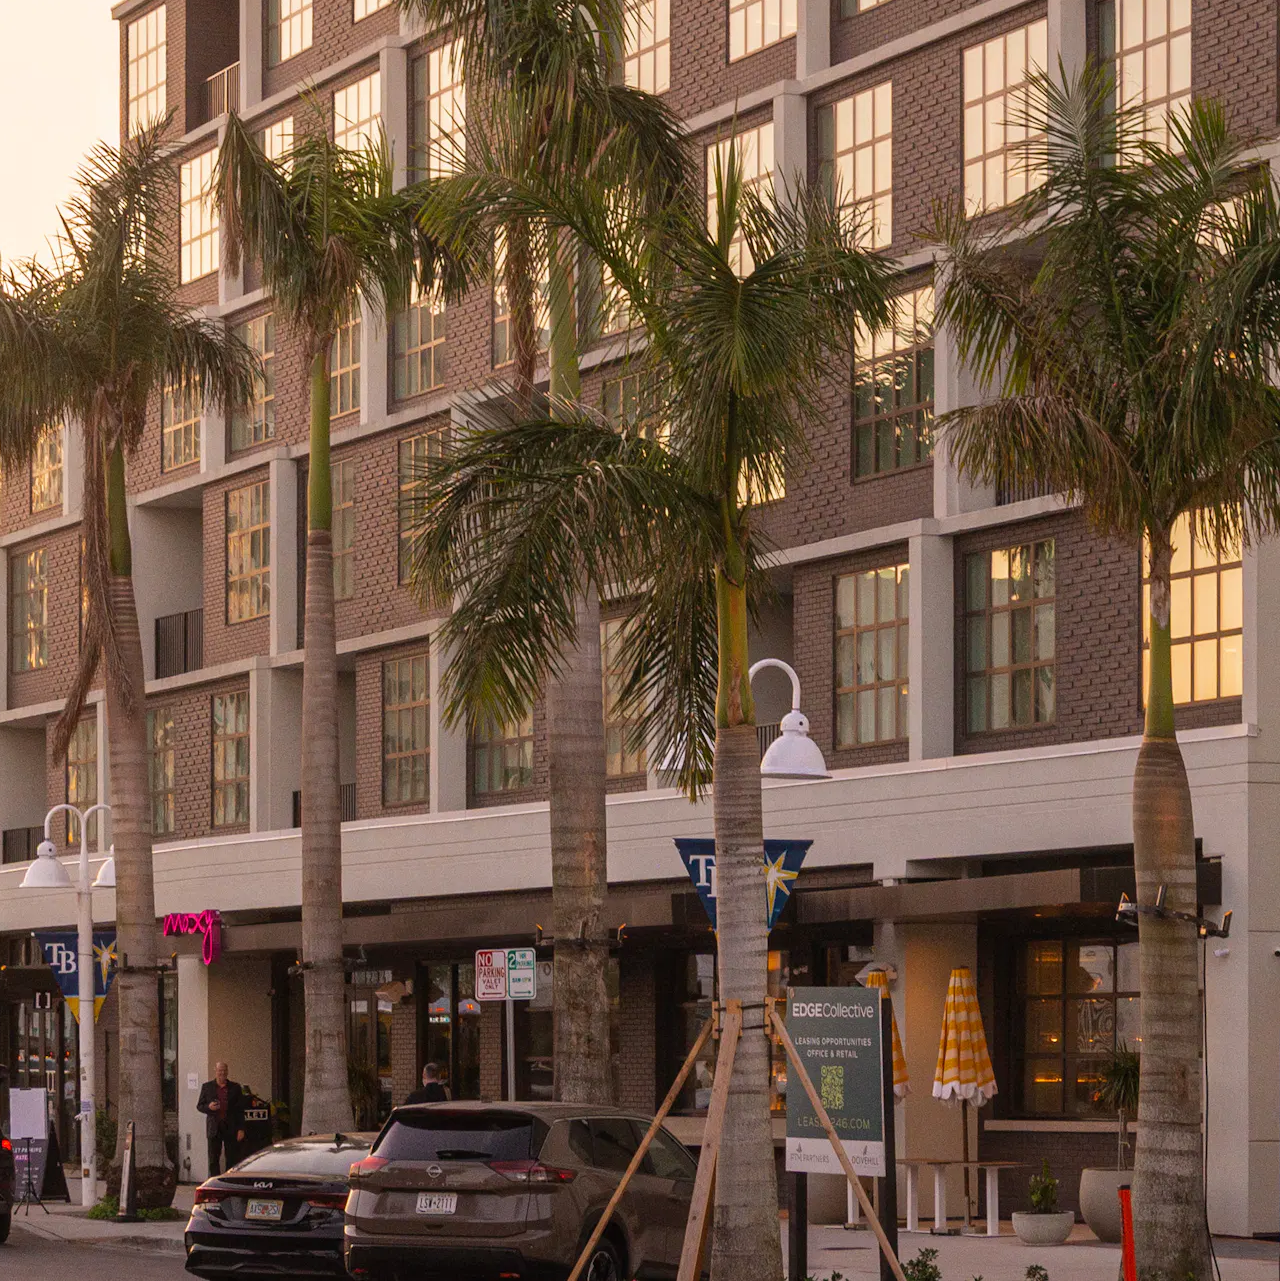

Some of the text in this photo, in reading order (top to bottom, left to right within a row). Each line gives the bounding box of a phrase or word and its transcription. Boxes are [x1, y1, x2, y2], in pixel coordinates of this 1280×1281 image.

[45, 943, 77, 974] TB
[478, 953, 492, 967] NO
[508, 953, 516, 968] 2
[479, 967, 505, 978] PARKING
[792, 1002, 874, 1018] EDGECollective
[795, 1037, 872, 1047] LEASING OPPORTUNITIES
[807, 1049, 829, 1058] OFFICE
[836, 1050, 859, 1059] RETAIL
